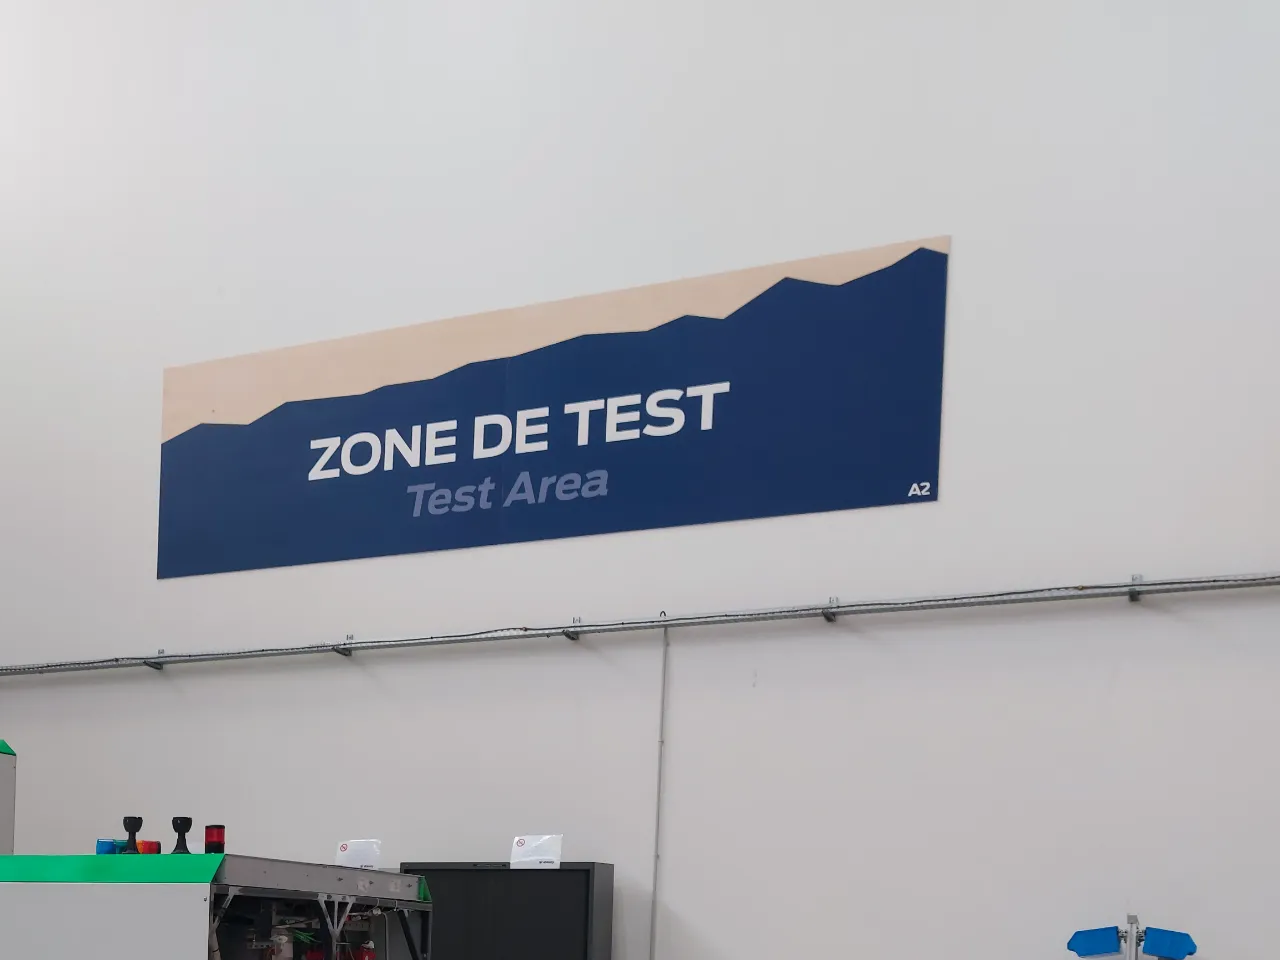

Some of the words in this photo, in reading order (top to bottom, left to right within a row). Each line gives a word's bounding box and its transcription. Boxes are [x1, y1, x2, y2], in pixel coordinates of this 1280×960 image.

[307, 419, 458, 481] ZONE
[472, 406, 550, 460] DE
[563, 381, 731, 446] TEST
[406, 476, 496, 518] Test
[502, 468, 610, 508] Area
[907, 481, 931, 497] A2
